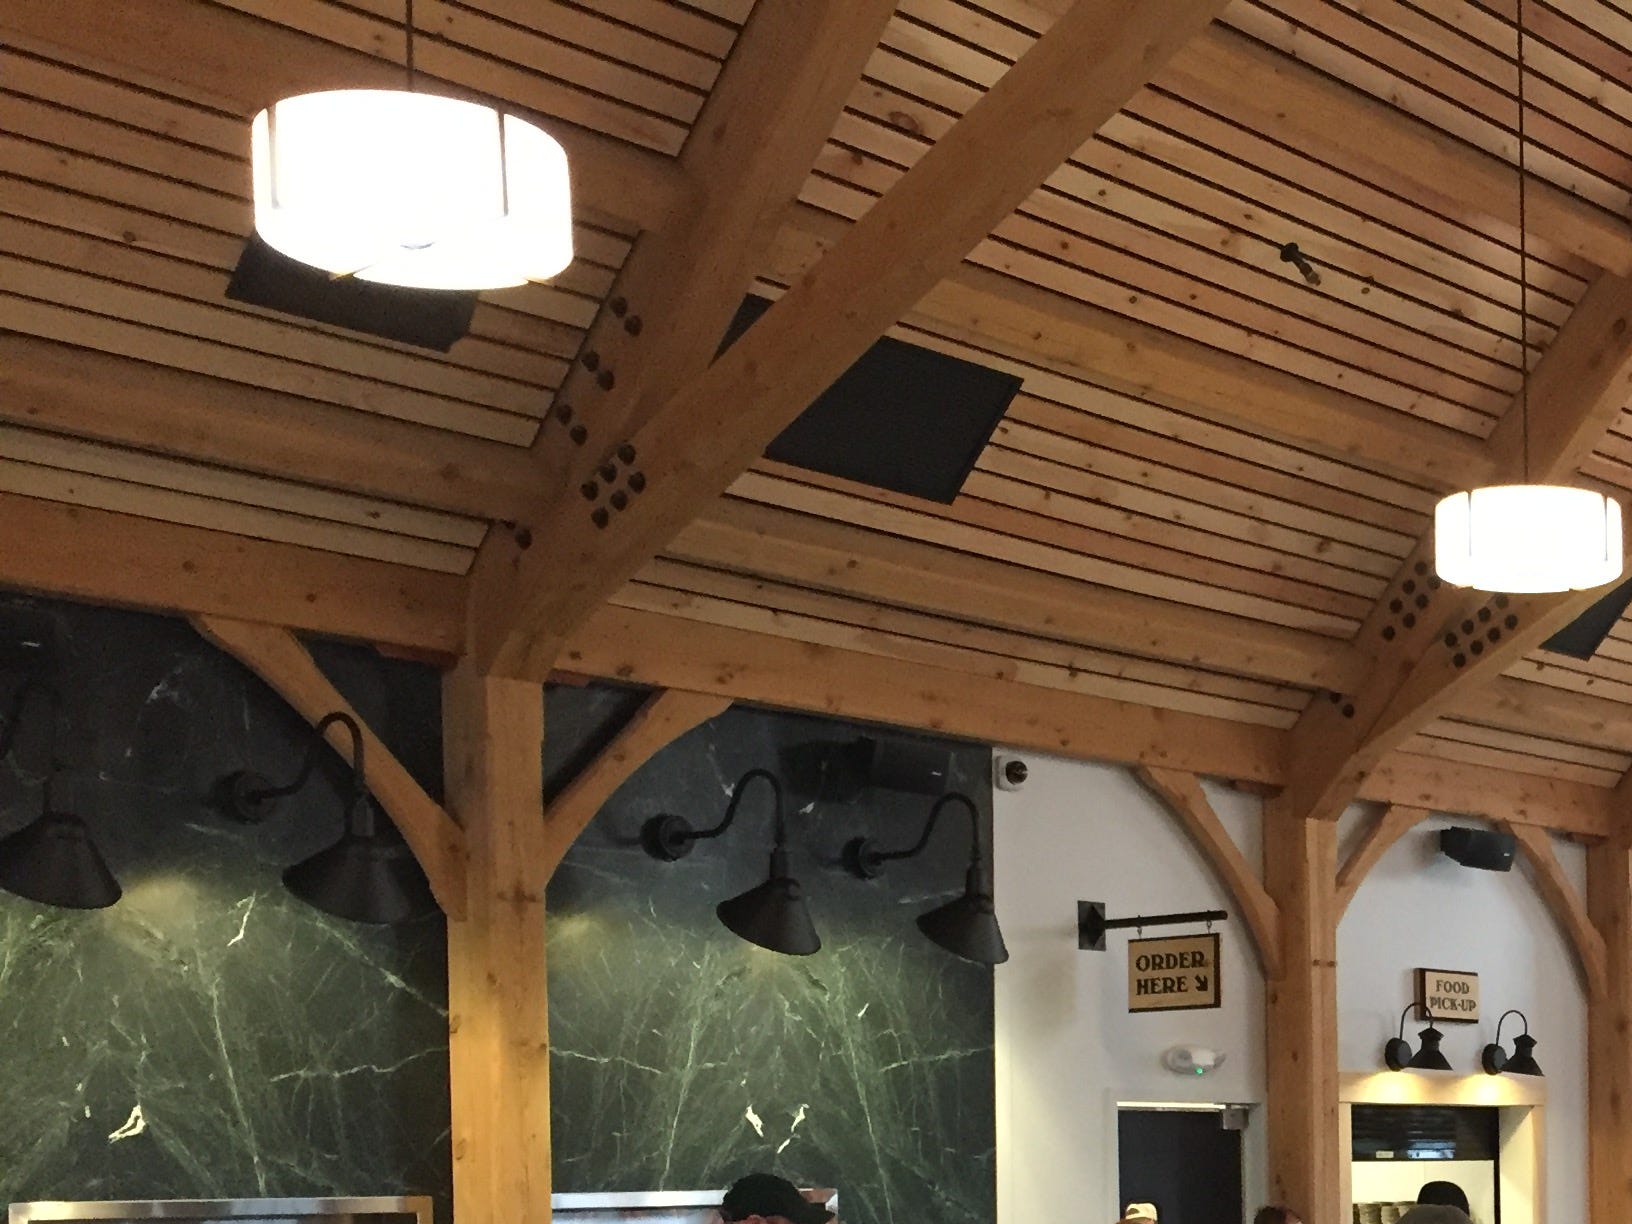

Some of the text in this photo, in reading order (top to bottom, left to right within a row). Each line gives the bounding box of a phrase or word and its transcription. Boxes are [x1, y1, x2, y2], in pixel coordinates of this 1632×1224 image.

[1136, 951, 1206, 971] ORDER
[1136, 976, 1188, 995] HERE
[1435, 979, 1470, 994] FOOD
[1430, 996, 1477, 1011] PICK-UP
